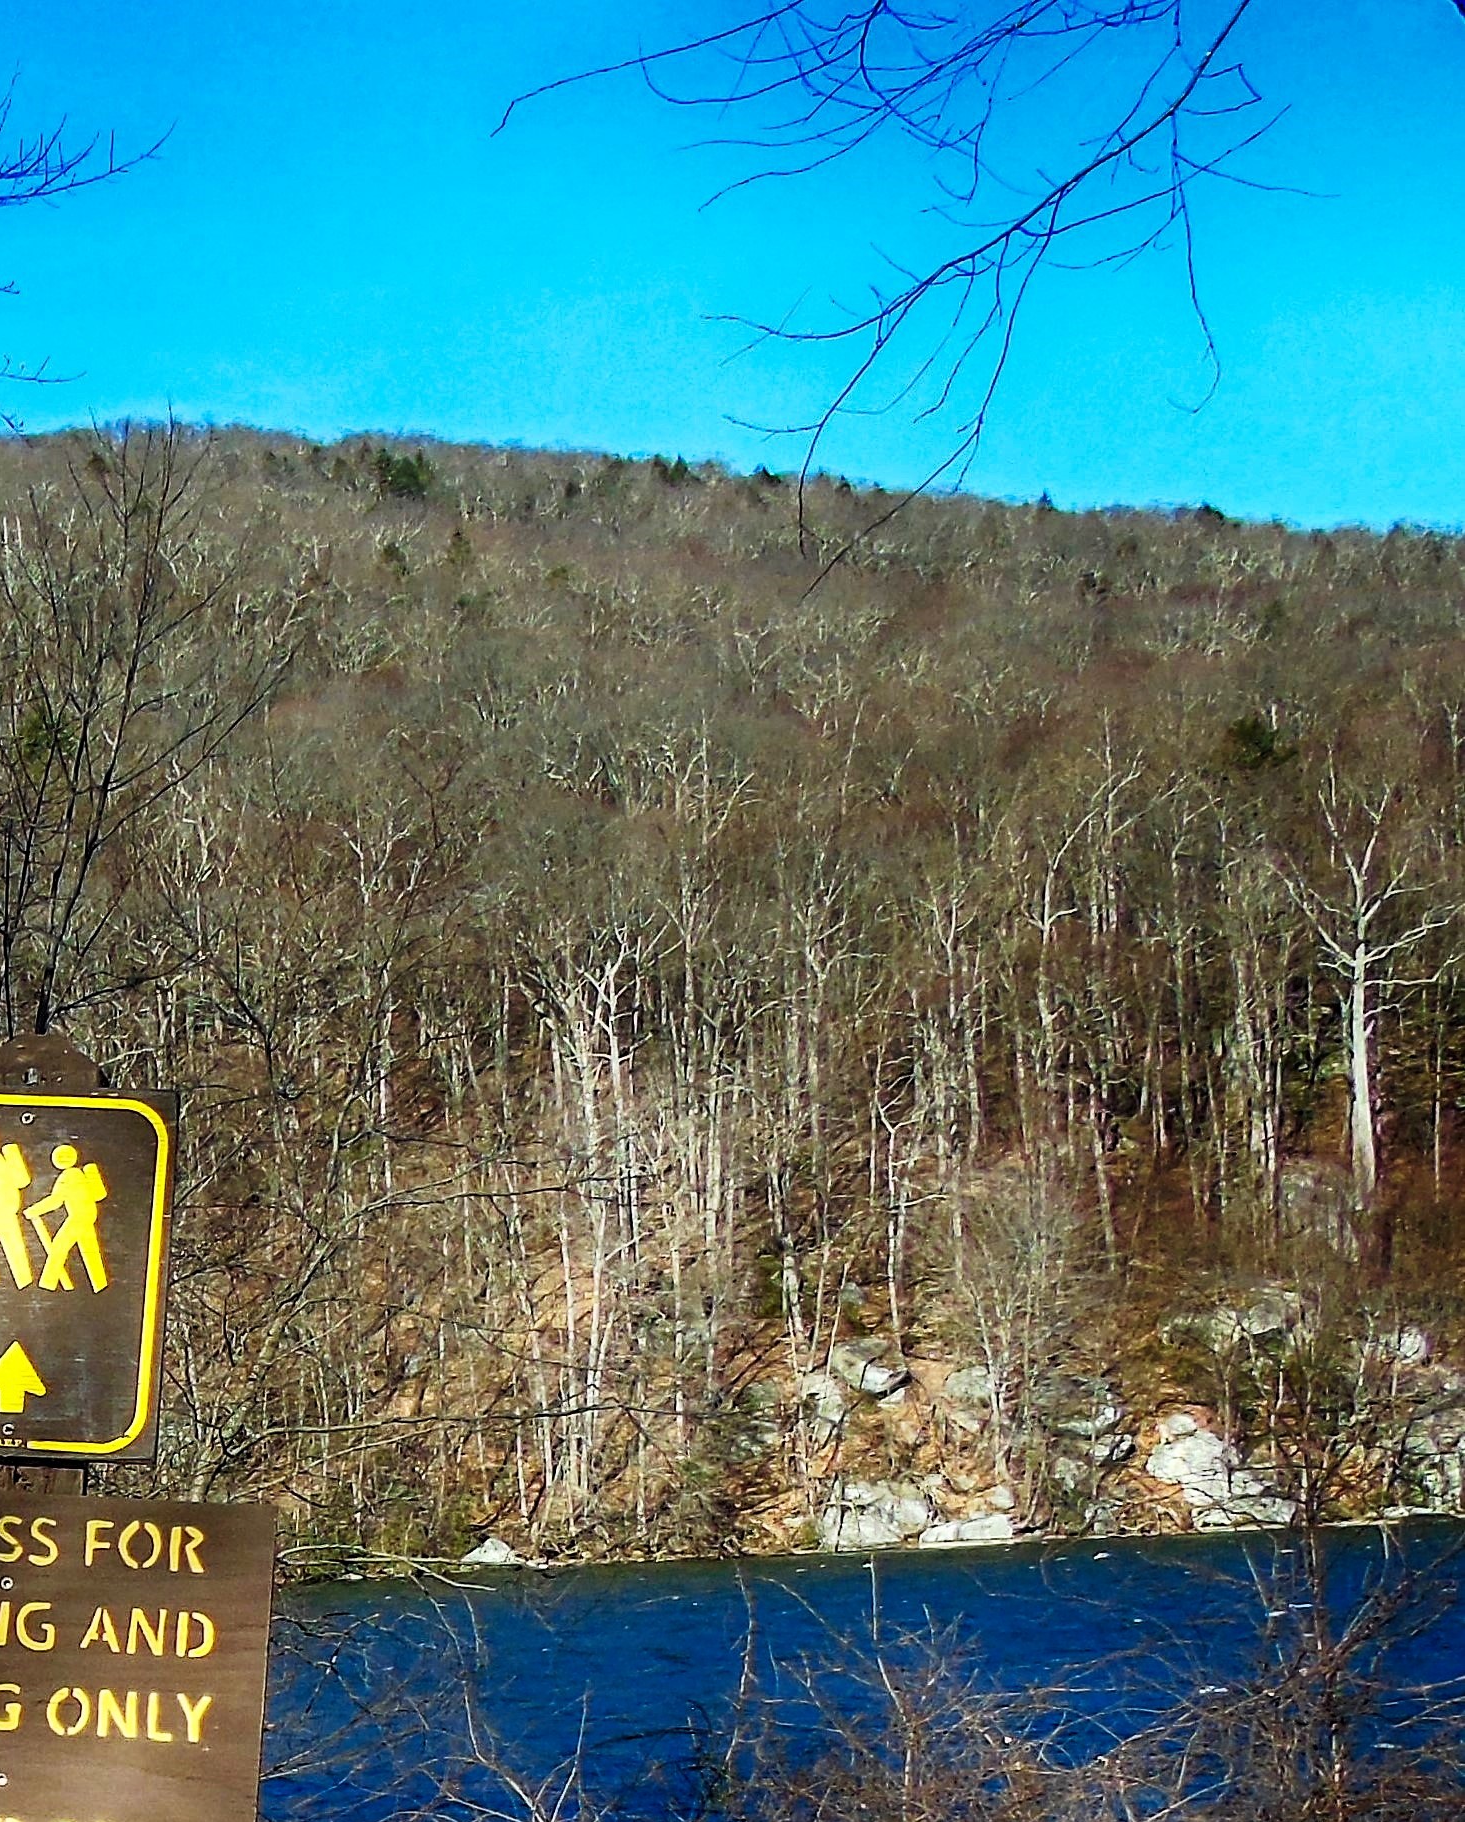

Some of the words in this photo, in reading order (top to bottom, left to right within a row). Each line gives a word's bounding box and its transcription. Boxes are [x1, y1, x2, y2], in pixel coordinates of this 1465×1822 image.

[84, 1519, 207, 1574] FOR
[80, 1606, 216, 1658] AND
[47, 1687, 214, 1743] ONLY
